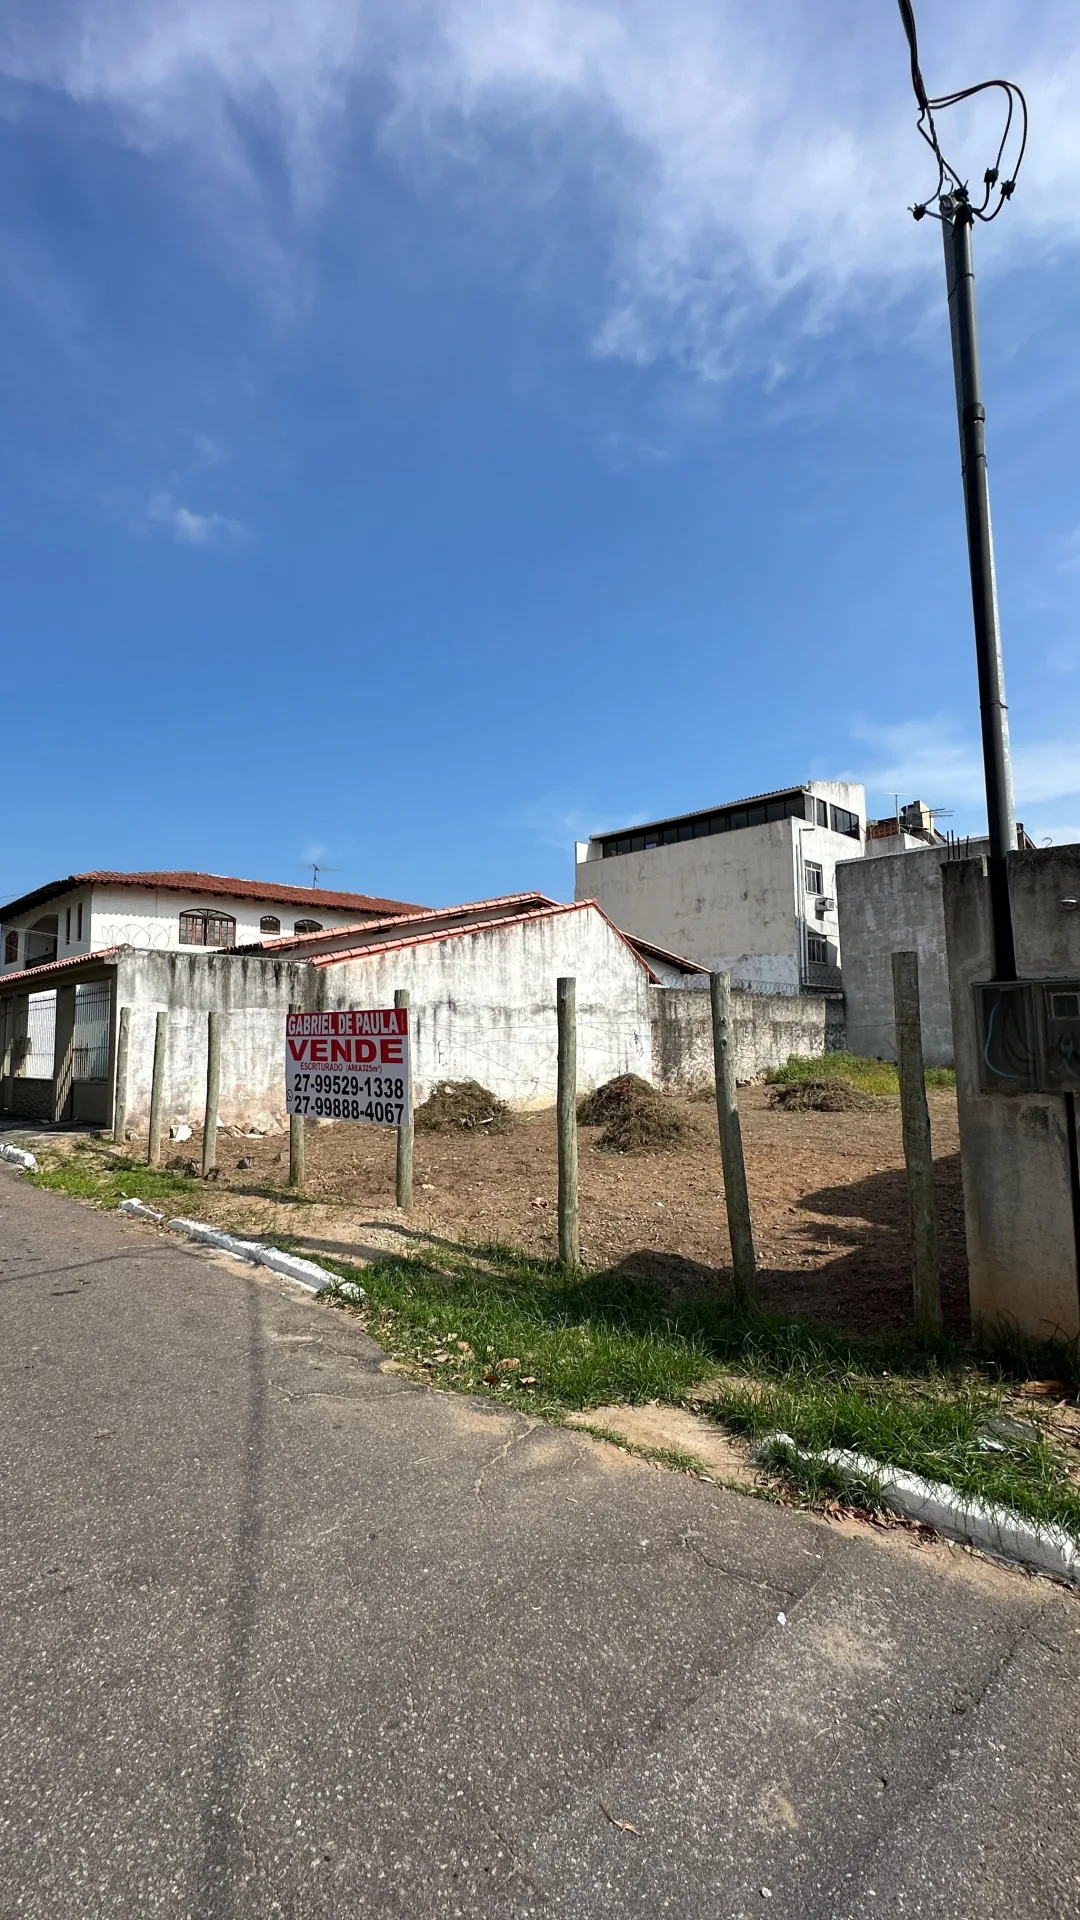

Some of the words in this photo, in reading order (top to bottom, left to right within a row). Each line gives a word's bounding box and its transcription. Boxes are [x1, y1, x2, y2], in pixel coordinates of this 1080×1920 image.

[288, 1014, 336, 1035] GABRIEL
[338, 1013, 353, 1035] DE
[355, 1011, 400, 1034] PAULA
[287, 1038, 404, 1064] VENDE
[300, 1061, 343, 1072] ESCRITURADO
[294, 1073, 404, 1099] 27-99529-1338
[294, 1095, 404, 1125] 27-99888-4067
